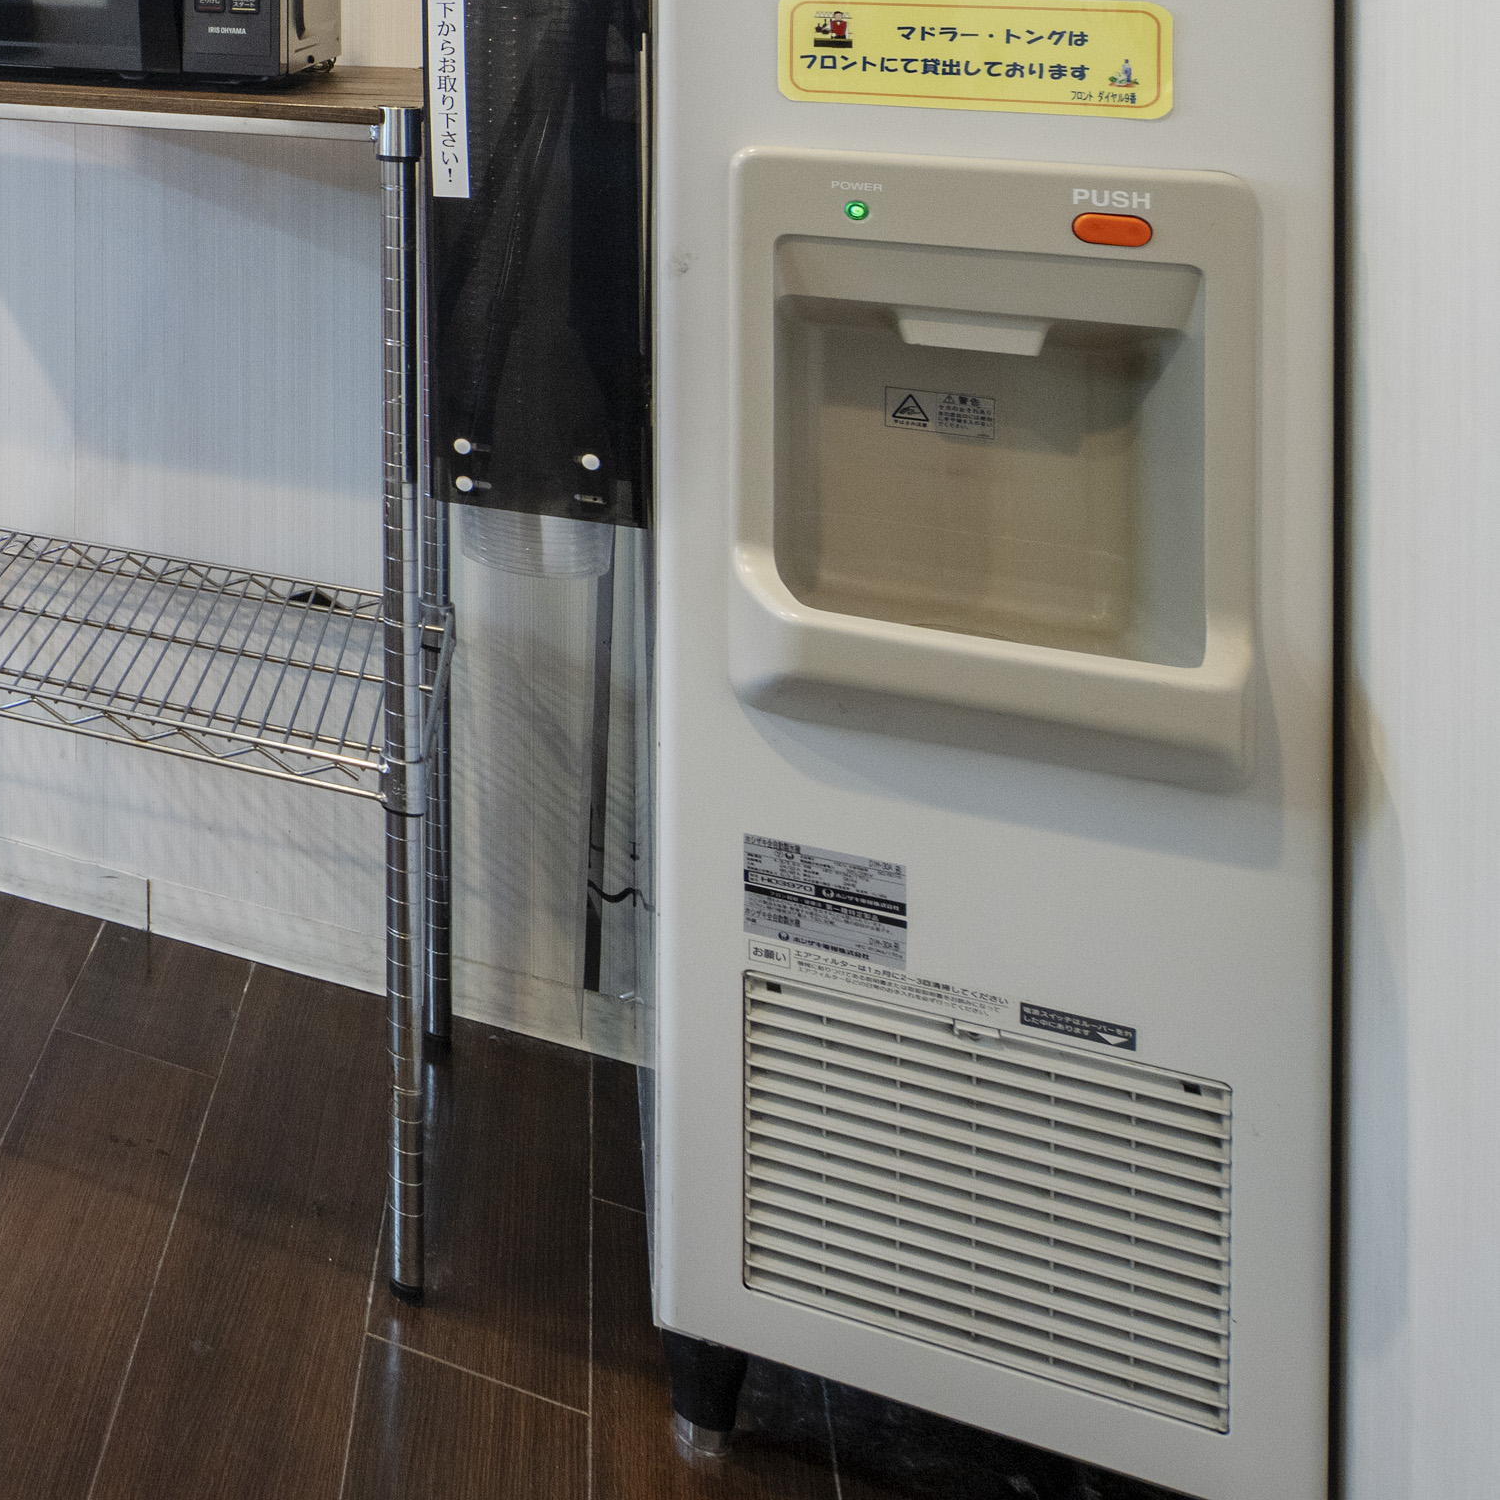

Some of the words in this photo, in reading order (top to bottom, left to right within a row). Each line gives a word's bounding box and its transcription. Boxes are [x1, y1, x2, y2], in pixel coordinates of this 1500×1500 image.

[208, 26, 220, 34] IRIS
[220, 27, 247, 35] OHYAMA
[897, 25, 1089, 47] マドラー・トングは
[800, 54, 1090, 81] フロントにて貸出しております
[435, 1, 460, 184] 下からお取り下さい!
[1071, 89, 1094, 102] フロント
[1098, 90, 1137, 105] ダイヤル9番
[831, 180, 883, 192] POWER
[1073, 189, 1151, 209] PUSH
[752, 948, 787, 962] お願い
